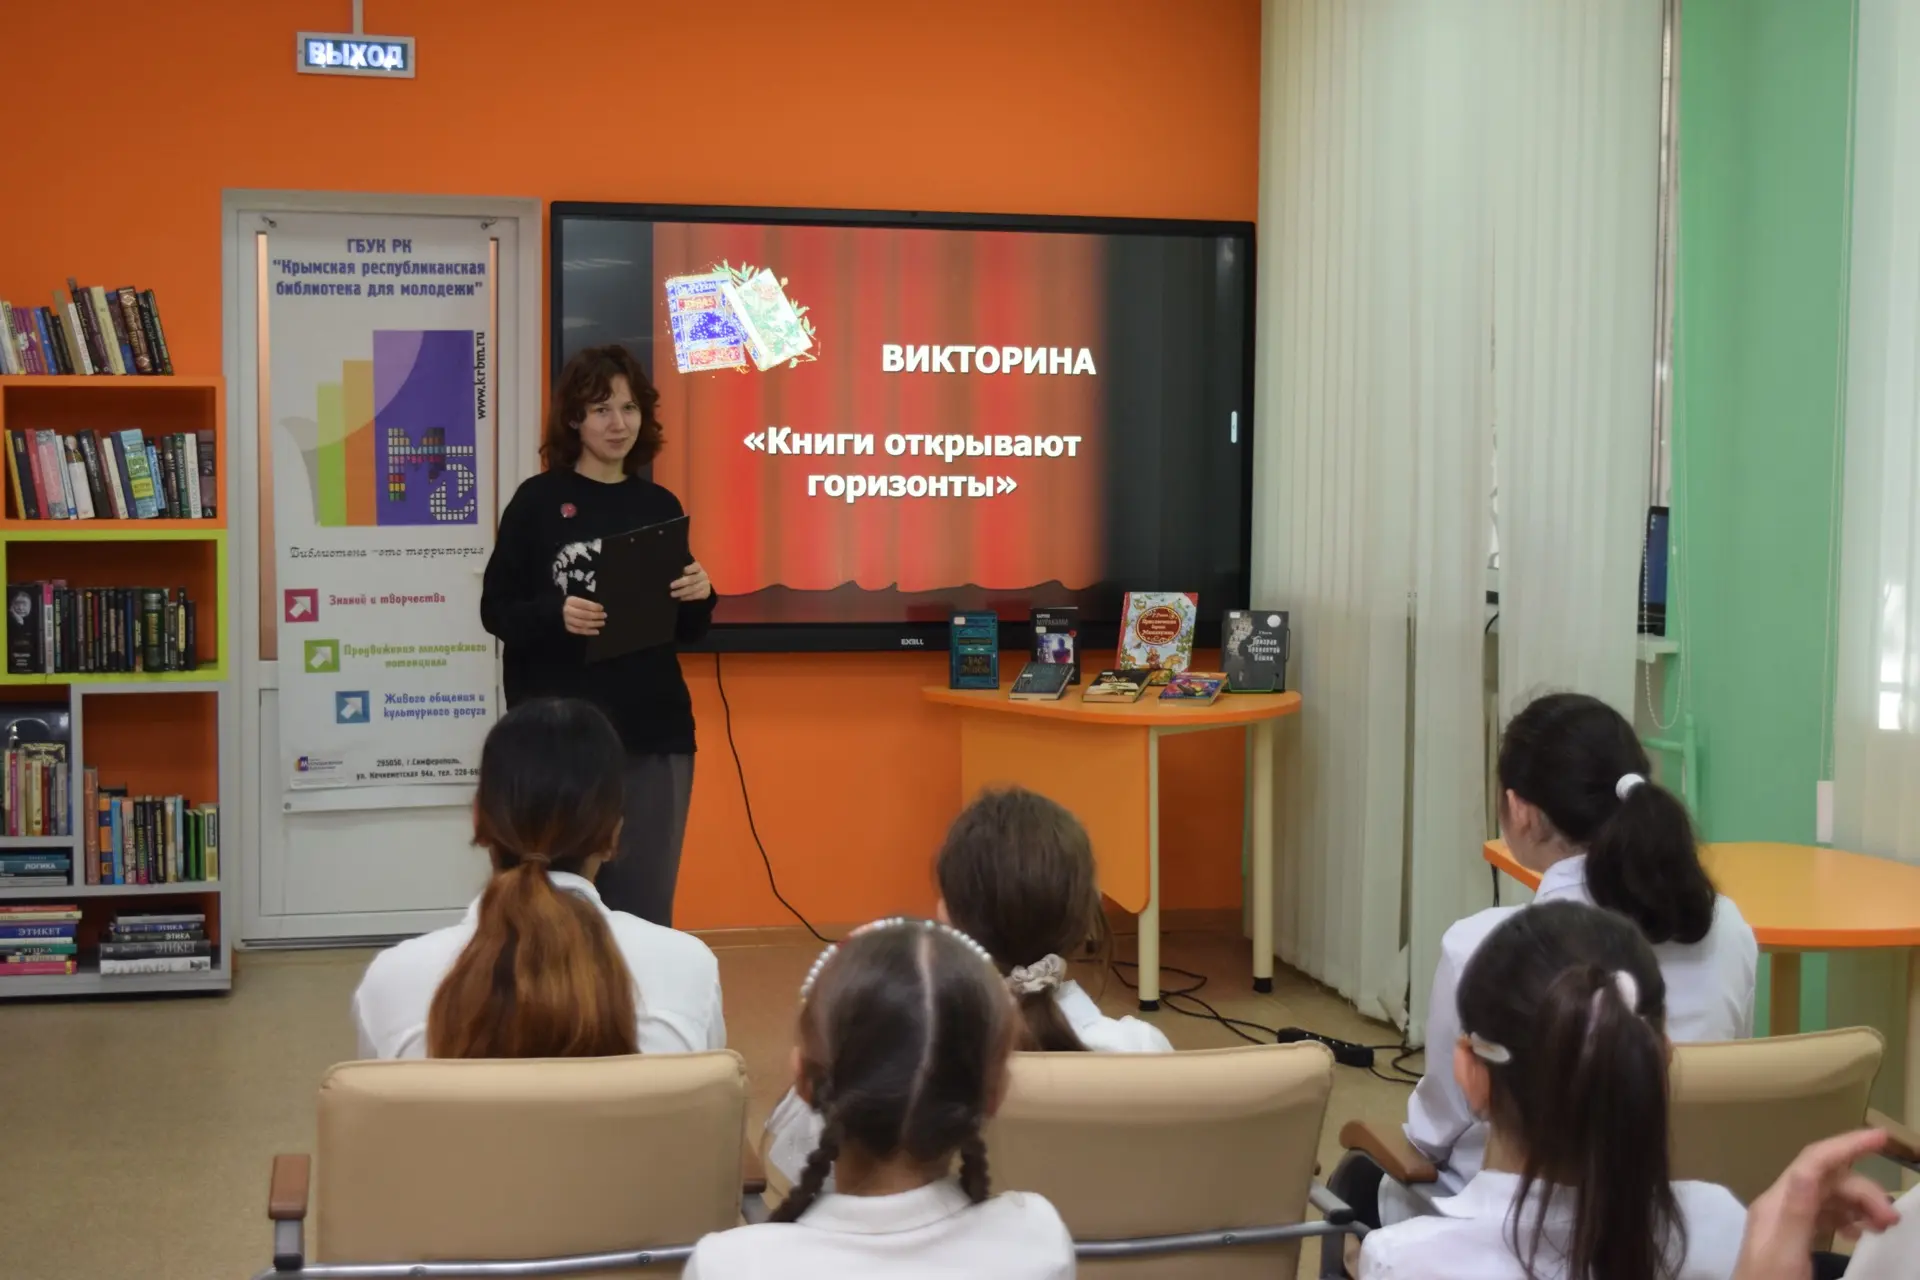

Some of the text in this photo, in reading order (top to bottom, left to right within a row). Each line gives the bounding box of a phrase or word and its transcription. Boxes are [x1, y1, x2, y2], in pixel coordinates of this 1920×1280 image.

[309, 41, 404, 69] ВЫХОД
[347, 238, 412, 253] ГБУК РК
[361, 260, 485, 277] республиканская
[276, 281, 361, 296] библиотека
[367, 283, 394, 297] для
[881, 344, 1096, 375] ВИКТОРИНА
[474, 331, 486, 420] www.krbm.ru
[743, 426, 1082, 462] «Книги открывают
[806, 472, 1017, 503] горизонты»
[290, 546, 367, 559] Библиотека
[405, 546, 484, 558] территория
[329, 594, 367, 606] Знаний
[380, 593, 446, 606] творчества
[343, 644, 415, 659] Продвижения
[385, 658, 447, 669] потенциала
[384, 693, 425, 704] Живого
[430, 692, 475, 704] общения
[384, 706, 486, 720] культурного досуга
[25, 862, 56, 871] ЛОГИКА
[18, 927, 61, 937] ЭТИКЕТ
[164, 932, 191, 941] ЭТИКА
